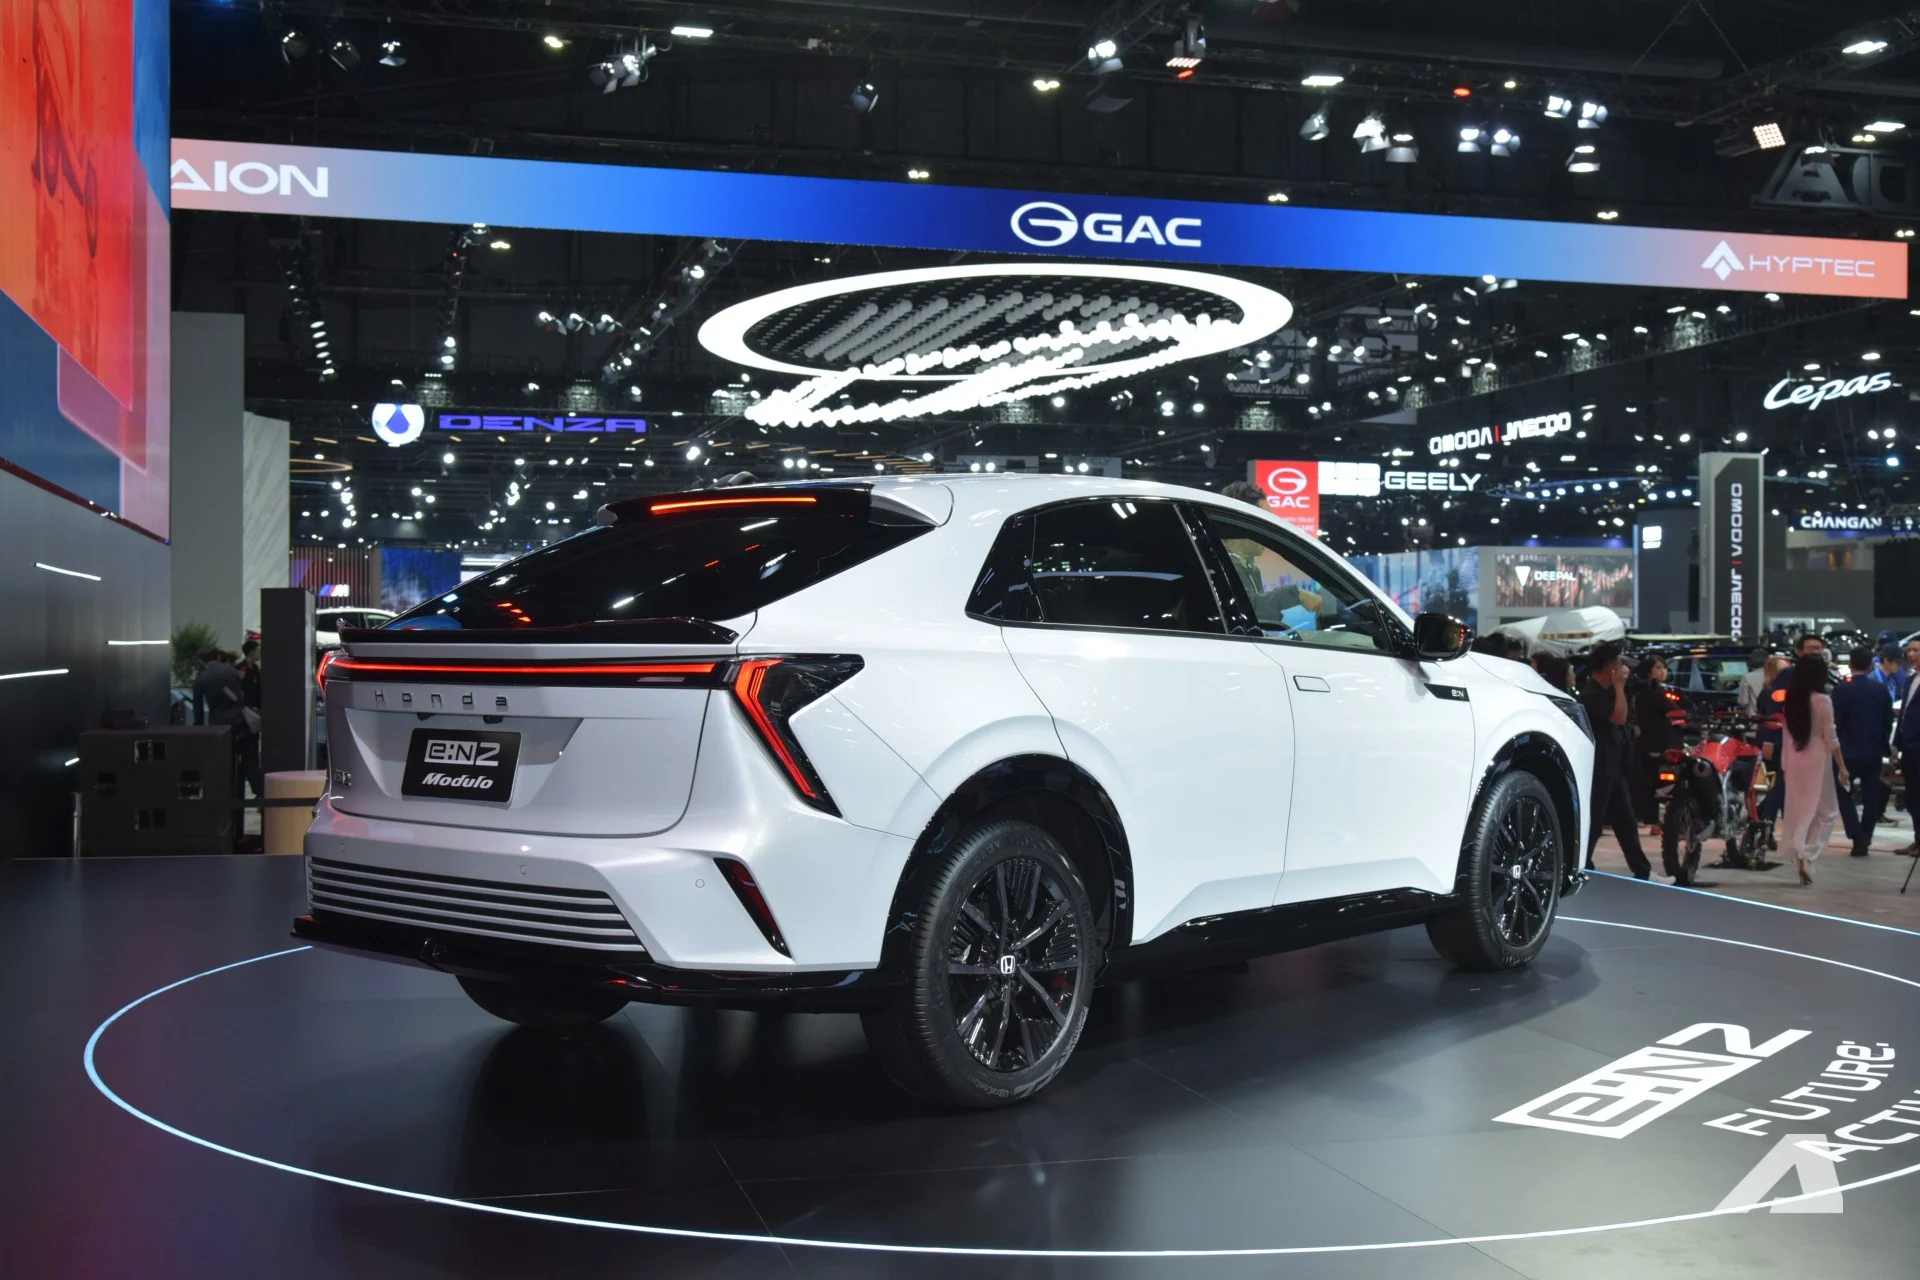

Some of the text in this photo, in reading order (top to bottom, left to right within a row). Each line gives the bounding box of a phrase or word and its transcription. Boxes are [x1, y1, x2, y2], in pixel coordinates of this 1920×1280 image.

[170, 158, 329, 198] AION
[1083, 212, 1202, 247] GAC
[1749, 255, 1876, 278] HYPTEC
[439, 414, 647, 433] DENZA
[1429, 426, 1493, 455] OMODA
[1384, 471, 1482, 491] GEELY
[1267, 496, 1310, 508] GAC
[1730, 483, 1743, 557] OMODA
[1800, 516, 1883, 530] CHANGAN
[1534, 570, 1577, 582] DEEPAL
[374, 689, 508, 707] Honda
[422, 772, 494, 789] Modulo
